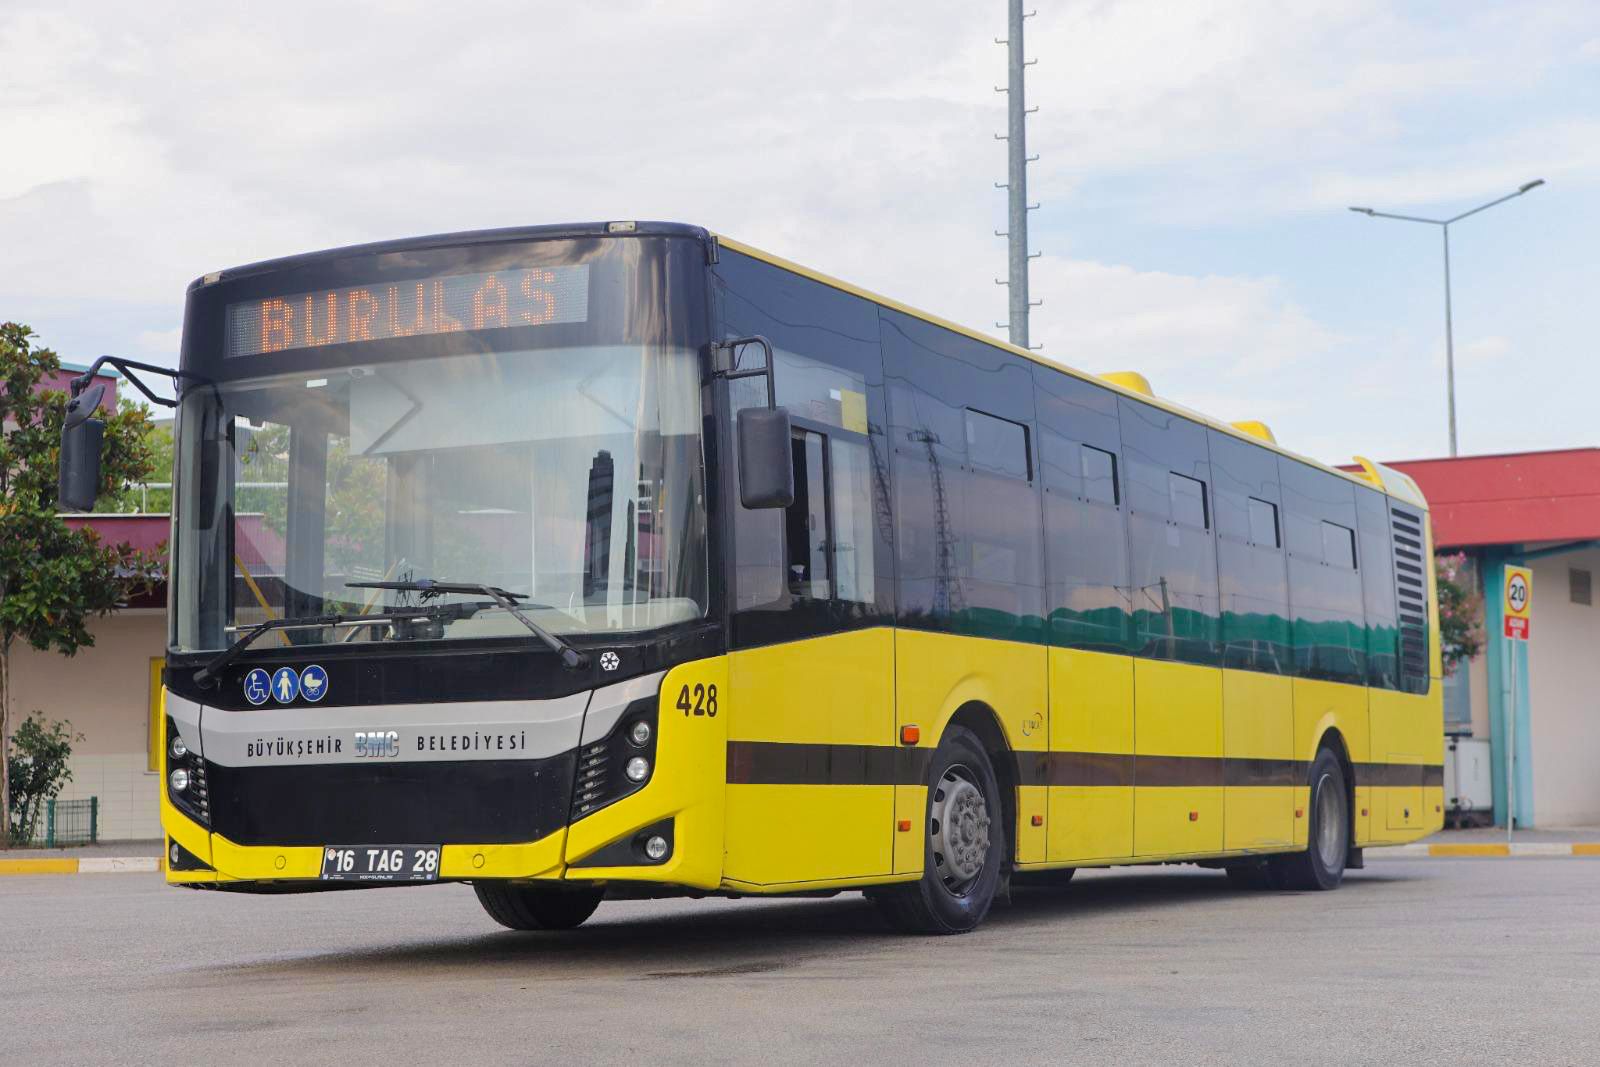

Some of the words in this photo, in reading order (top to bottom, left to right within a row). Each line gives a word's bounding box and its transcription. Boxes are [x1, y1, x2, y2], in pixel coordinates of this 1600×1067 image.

[260, 267, 556, 354] BURULAS
[1510, 584, 1525, 602] 20
[676, 683, 718, 718] 428
[247, 735, 342, 759] BÜYÜKŞEHİR
[354, 730, 400, 758] BMC
[417, 730, 525, 751] BELEDİYESİ
[336, 849, 356, 872] 16
[366, 849, 404, 872] TAG
[412, 849, 438, 872] 28
